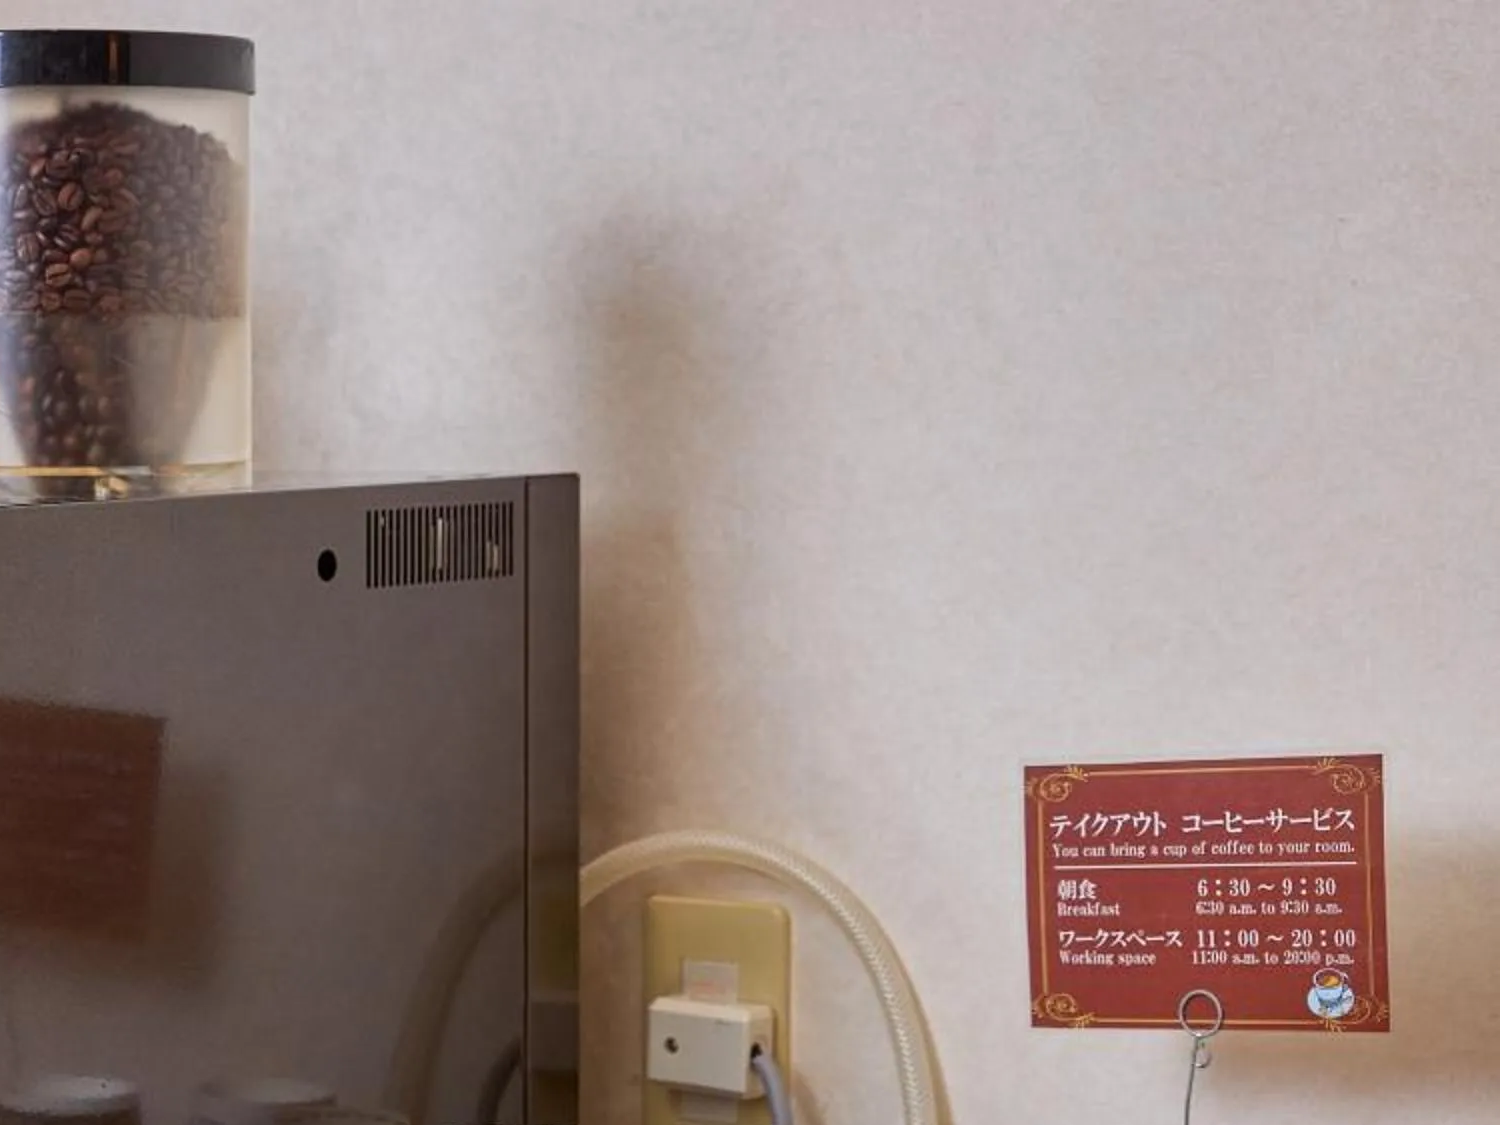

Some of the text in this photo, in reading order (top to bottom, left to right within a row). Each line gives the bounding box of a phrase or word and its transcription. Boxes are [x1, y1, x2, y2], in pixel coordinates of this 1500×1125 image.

[1049, 807, 1356, 838] テイクアウト コーヒーサービス
[1052, 840, 1356, 858] You can bring a cup of coffee to your room.
[1057, 878, 1098, 900] 朝食
[1057, 901, 1120, 917] Breakfast
[1195, 900, 1225, 915] 6:30
[1229, 902, 1257, 915] a.m.
[1261, 901, 1275, 914] to
[1280, 900, 1309, 914] 9:30
[1059, 928, 1184, 949] ワークスペース
[1059, 949, 1115, 966] Working
[1118, 952, 1157, 967] space
[1192, 950, 1228, 965] 11:00
[1264, 951, 1279, 964] to
[1283, 950, 1321, 965] 20:00
[1325, 953, 1355, 966] p.m.
